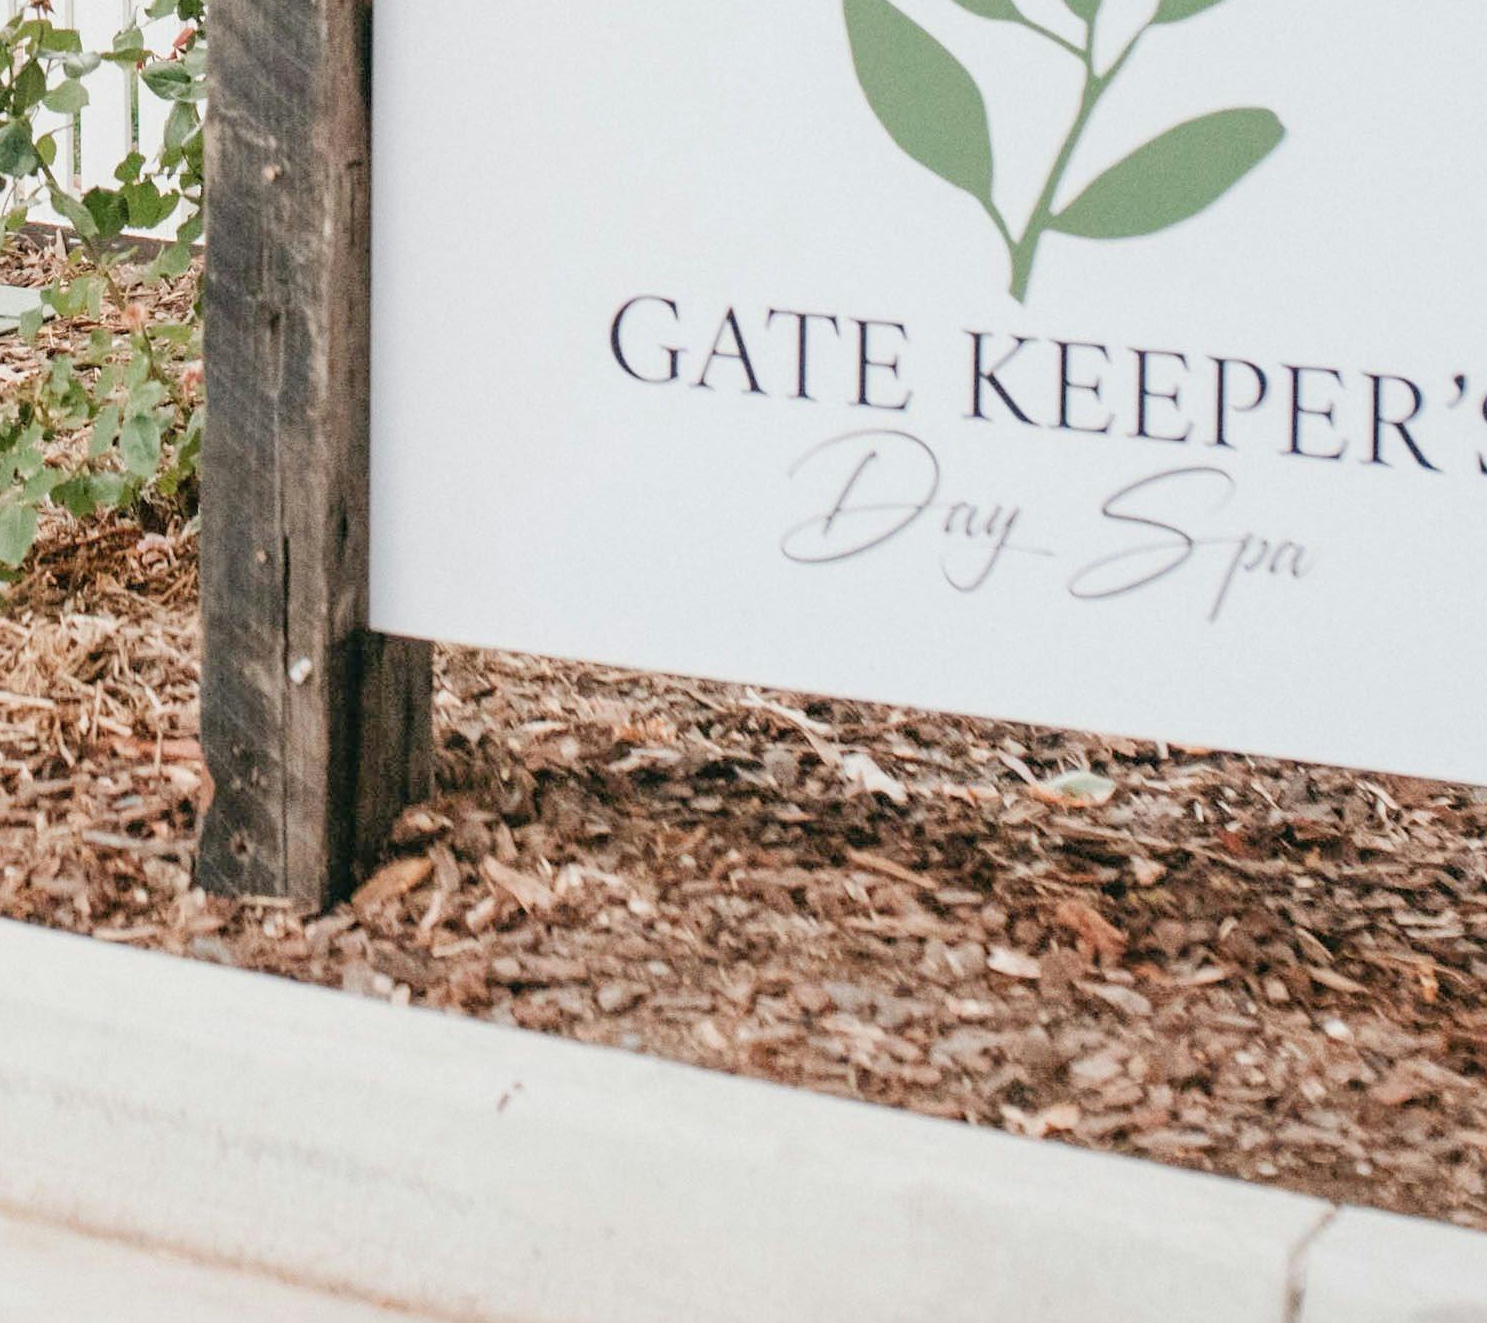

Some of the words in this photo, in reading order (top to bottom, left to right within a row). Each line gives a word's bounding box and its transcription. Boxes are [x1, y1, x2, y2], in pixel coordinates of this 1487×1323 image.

[609, 294, 912, 413] GATE
[781, 429, 1055, 592] Day
[1067, 466, 1315, 623] Spa
